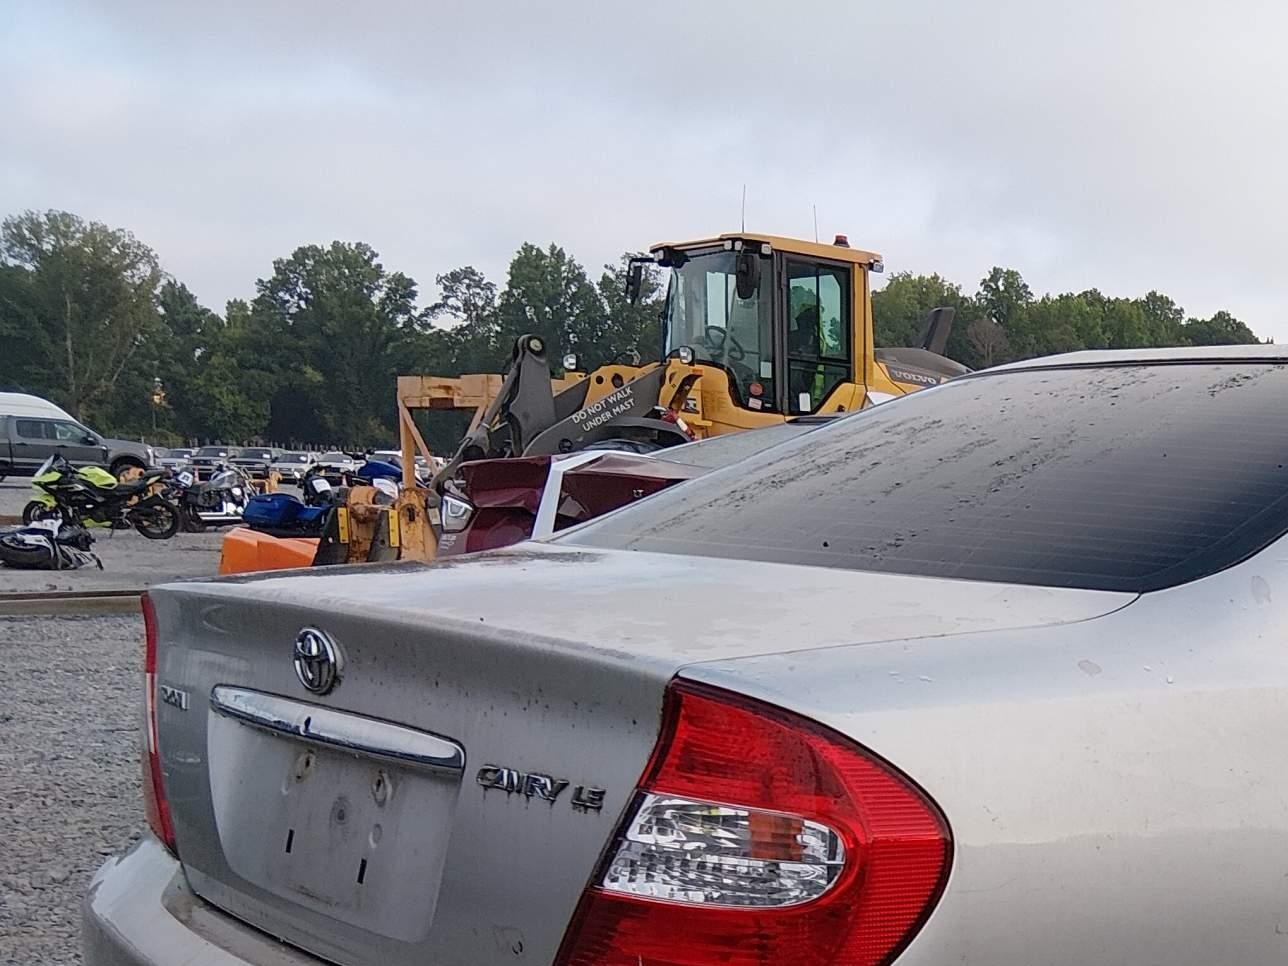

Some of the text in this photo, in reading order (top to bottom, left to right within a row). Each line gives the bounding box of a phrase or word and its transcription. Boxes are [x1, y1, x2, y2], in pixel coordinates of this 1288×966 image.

[892, 368, 937, 385] VOLVO
[571, 386, 633, 424] DO NOT WALK
[582, 398, 635, 431] UNDER MAST
[571, 785, 606, 810] LE
